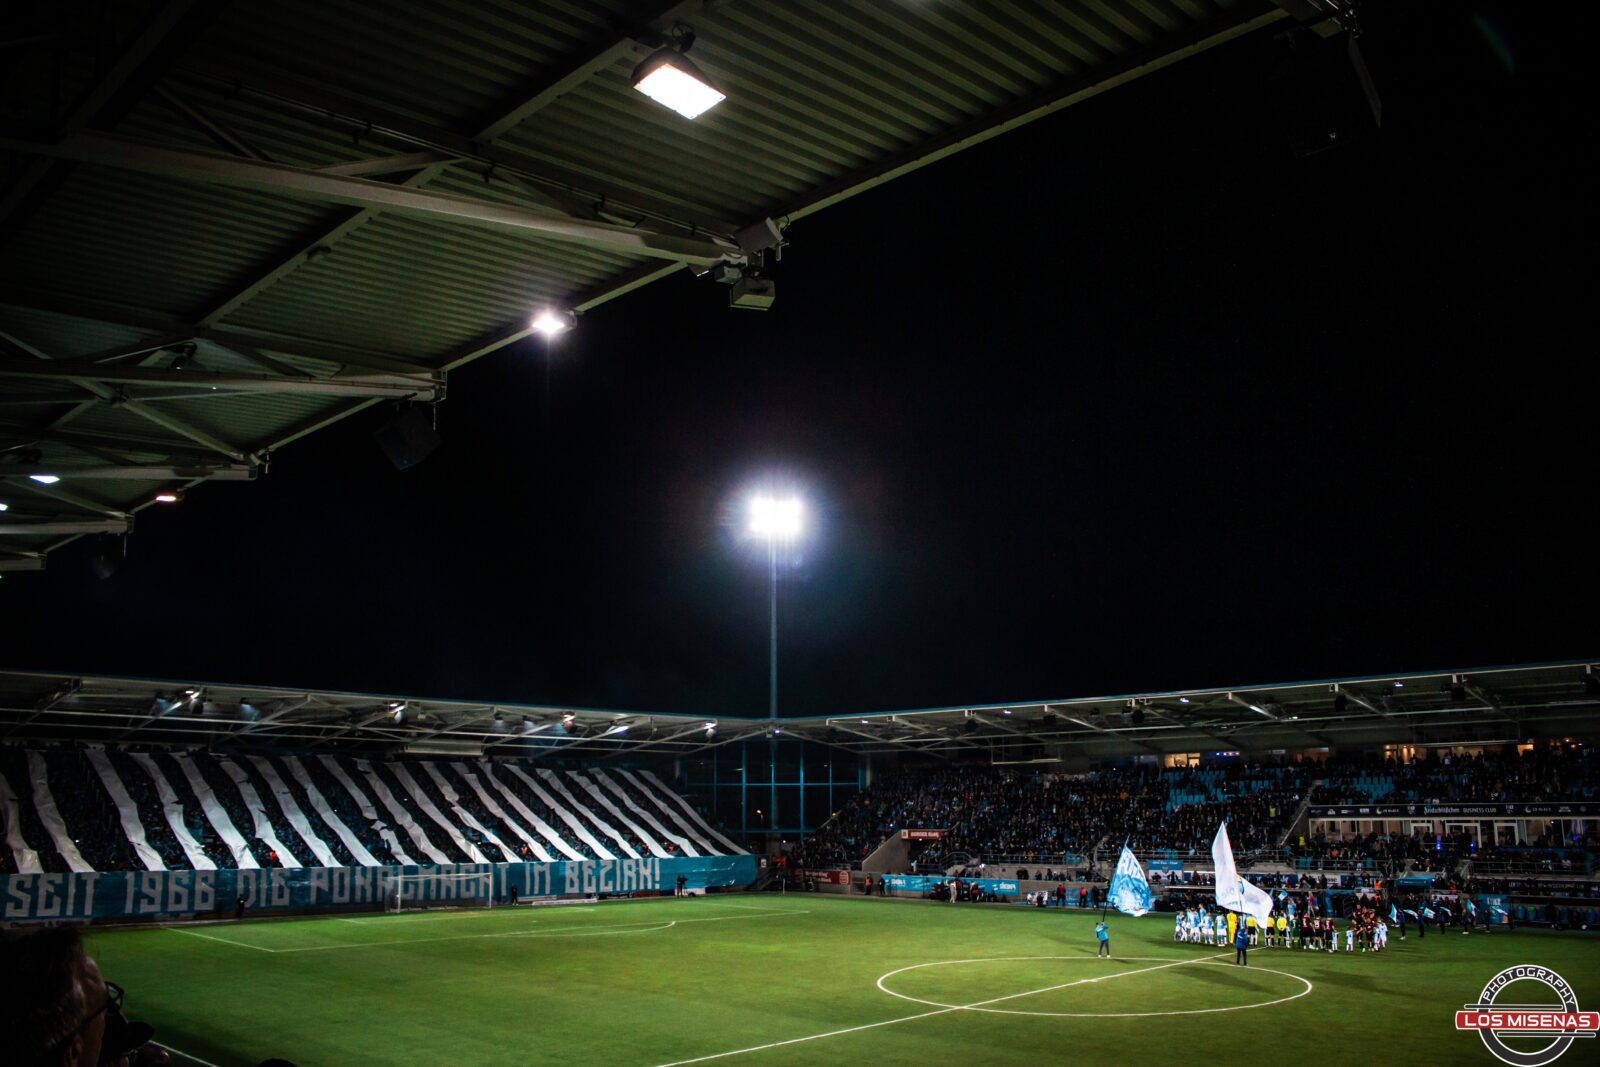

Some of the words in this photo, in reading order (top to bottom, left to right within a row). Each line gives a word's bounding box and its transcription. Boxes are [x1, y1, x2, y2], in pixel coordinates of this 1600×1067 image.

[5, 872, 100, 918] SEIT
[125, 868, 216, 914] 1966
[236, 866, 291, 909] DIE
[309, 863, 508, 906] POKALMACHT
[525, 862, 551, 894] IM
[565, 859, 660, 893] BEZIRK!
